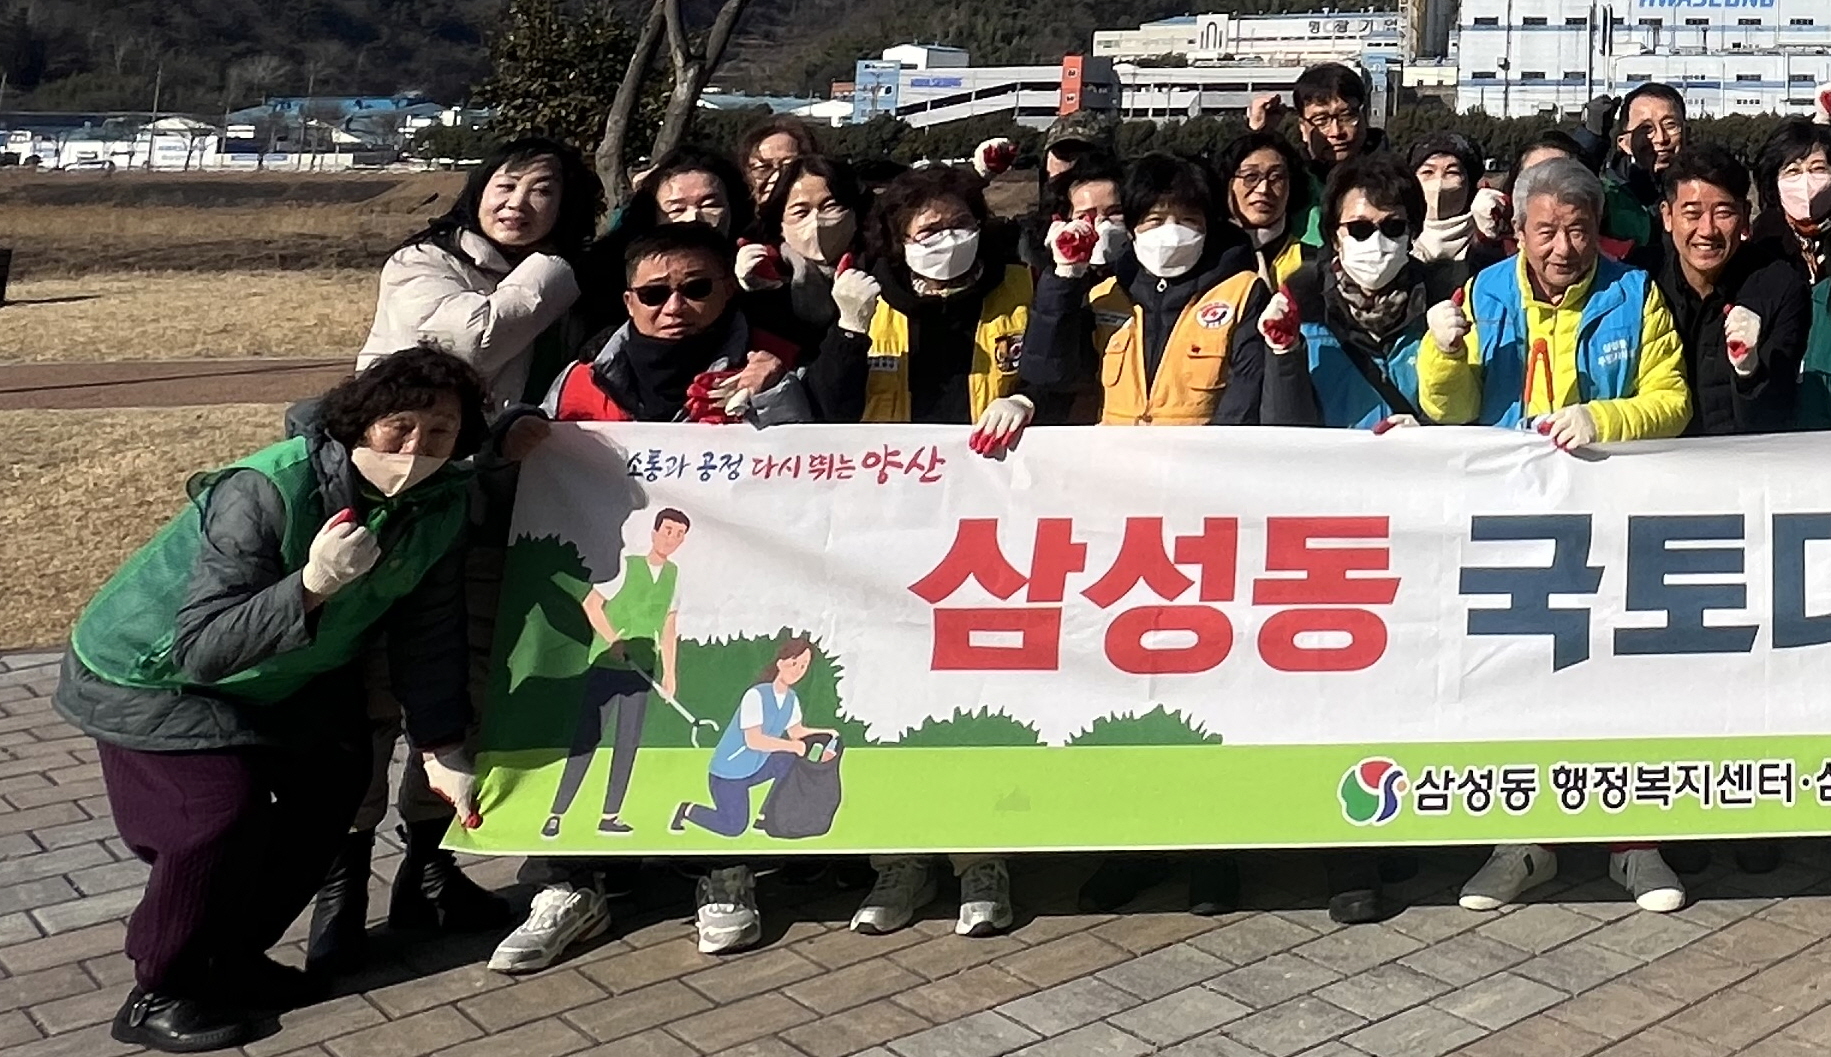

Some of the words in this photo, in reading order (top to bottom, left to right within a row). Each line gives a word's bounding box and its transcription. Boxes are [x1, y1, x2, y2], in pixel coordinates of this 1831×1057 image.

[627, 448, 691, 482] 소통과
[696, 450, 744, 482] 공정
[751, 453, 801, 480] 다시
[808, 453, 857, 480] 뛰는
[861, 443, 947, 485] 양산
[909, 516, 1401, 674] 삼성동
[1414, 768, 1537, 813] 삼성동
